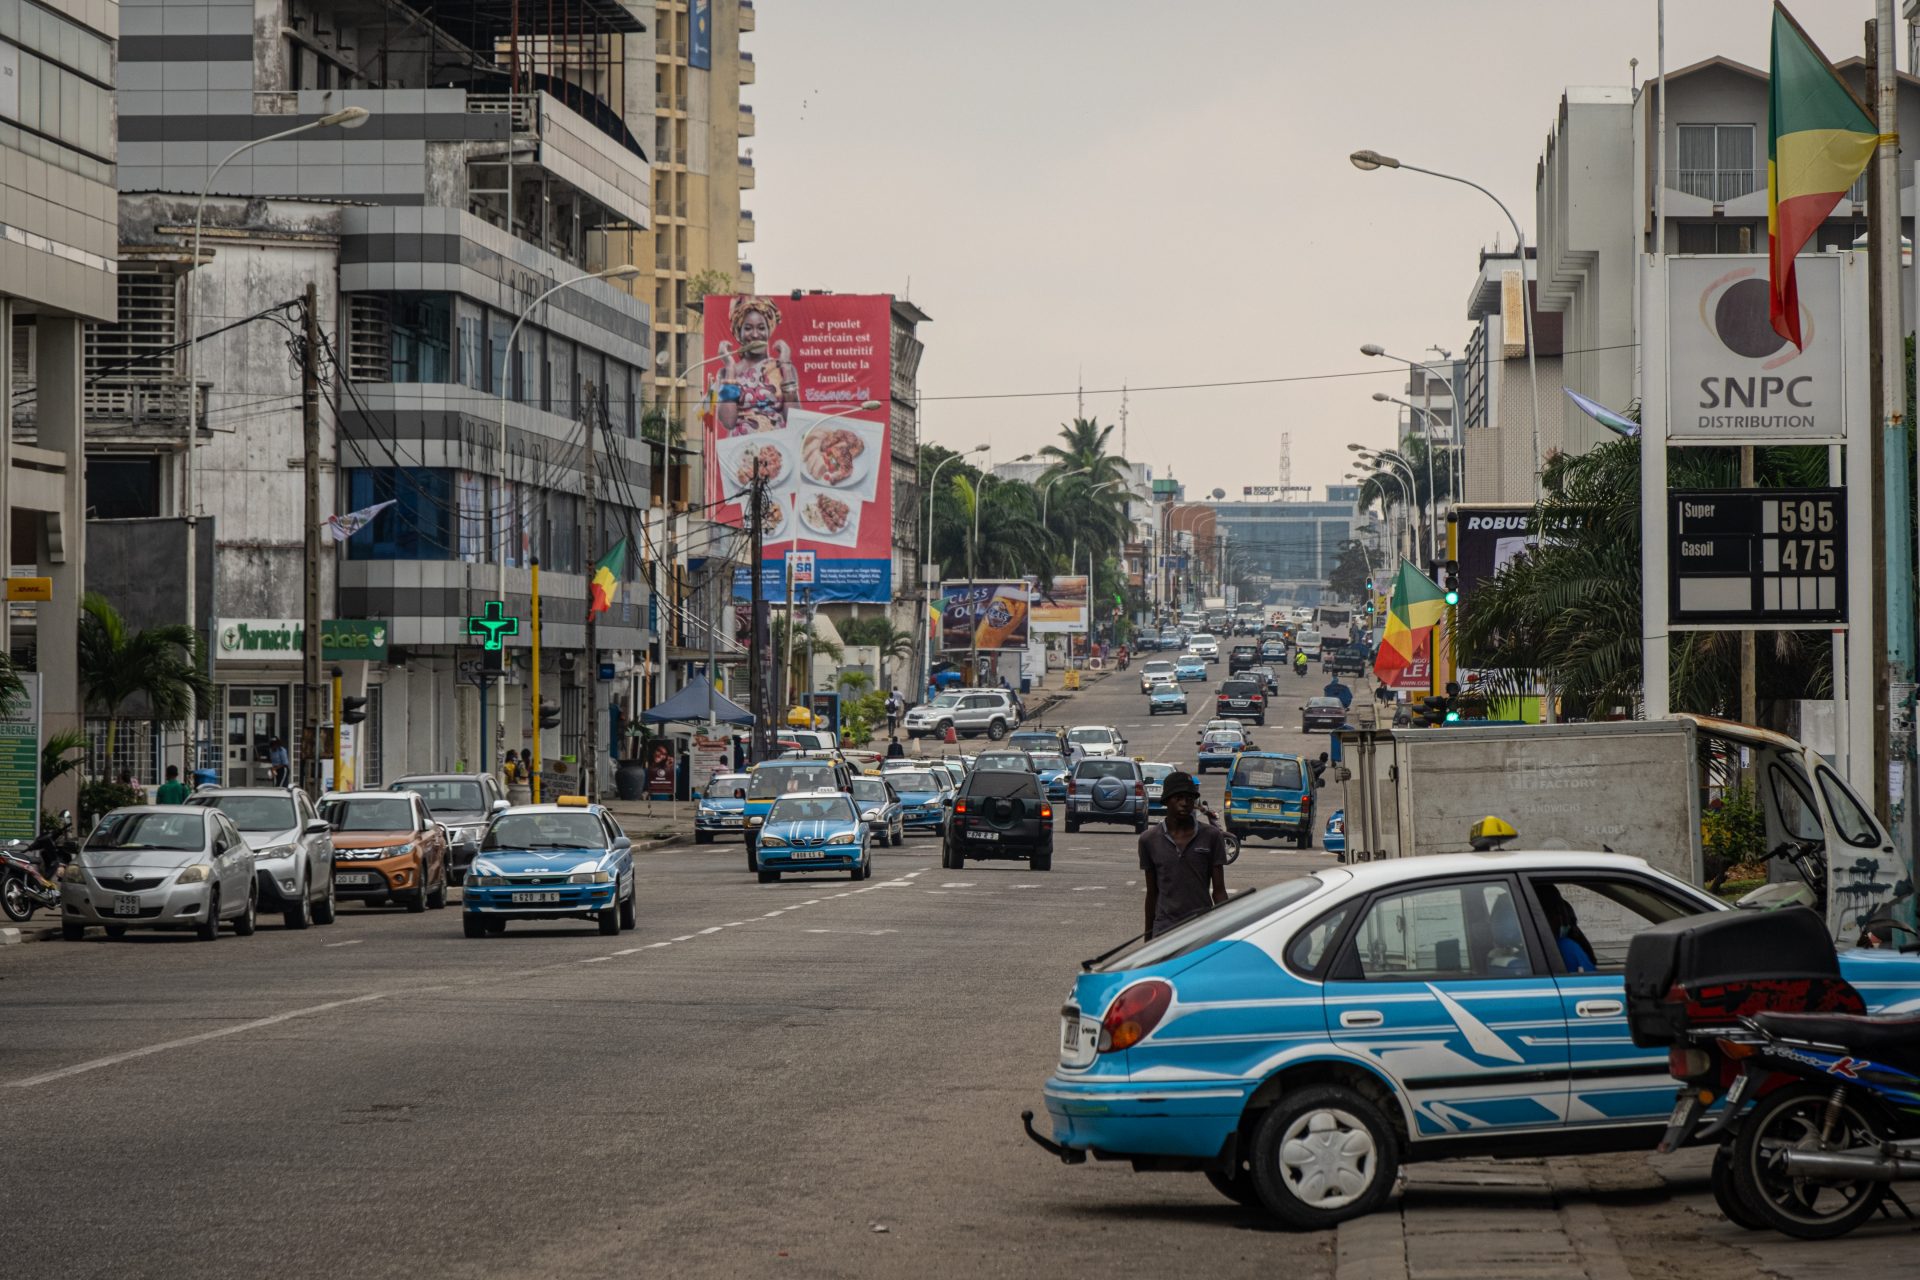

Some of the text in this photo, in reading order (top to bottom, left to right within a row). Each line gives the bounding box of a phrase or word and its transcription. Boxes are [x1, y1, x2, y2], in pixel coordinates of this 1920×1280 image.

[812, 319, 861, 331] Le poulet
[802, 333, 870, 343] américain est
[799, 346, 874, 356] sain et nutritif
[804, 359, 870, 373] pour toute la
[817, 373, 857, 383] famille.
[1699, 376, 1813, 409] SNPC
[1698, 415, 1815, 428] DISTRIBUTION
[1685, 501, 1834, 533] Super 595
[1681, 539, 1835, 571] Gasoil 475
[236, 622, 290, 651] Pharmacie
[319, 624, 370, 648] alais
[1540, 778, 1599, 789] FACTORY
